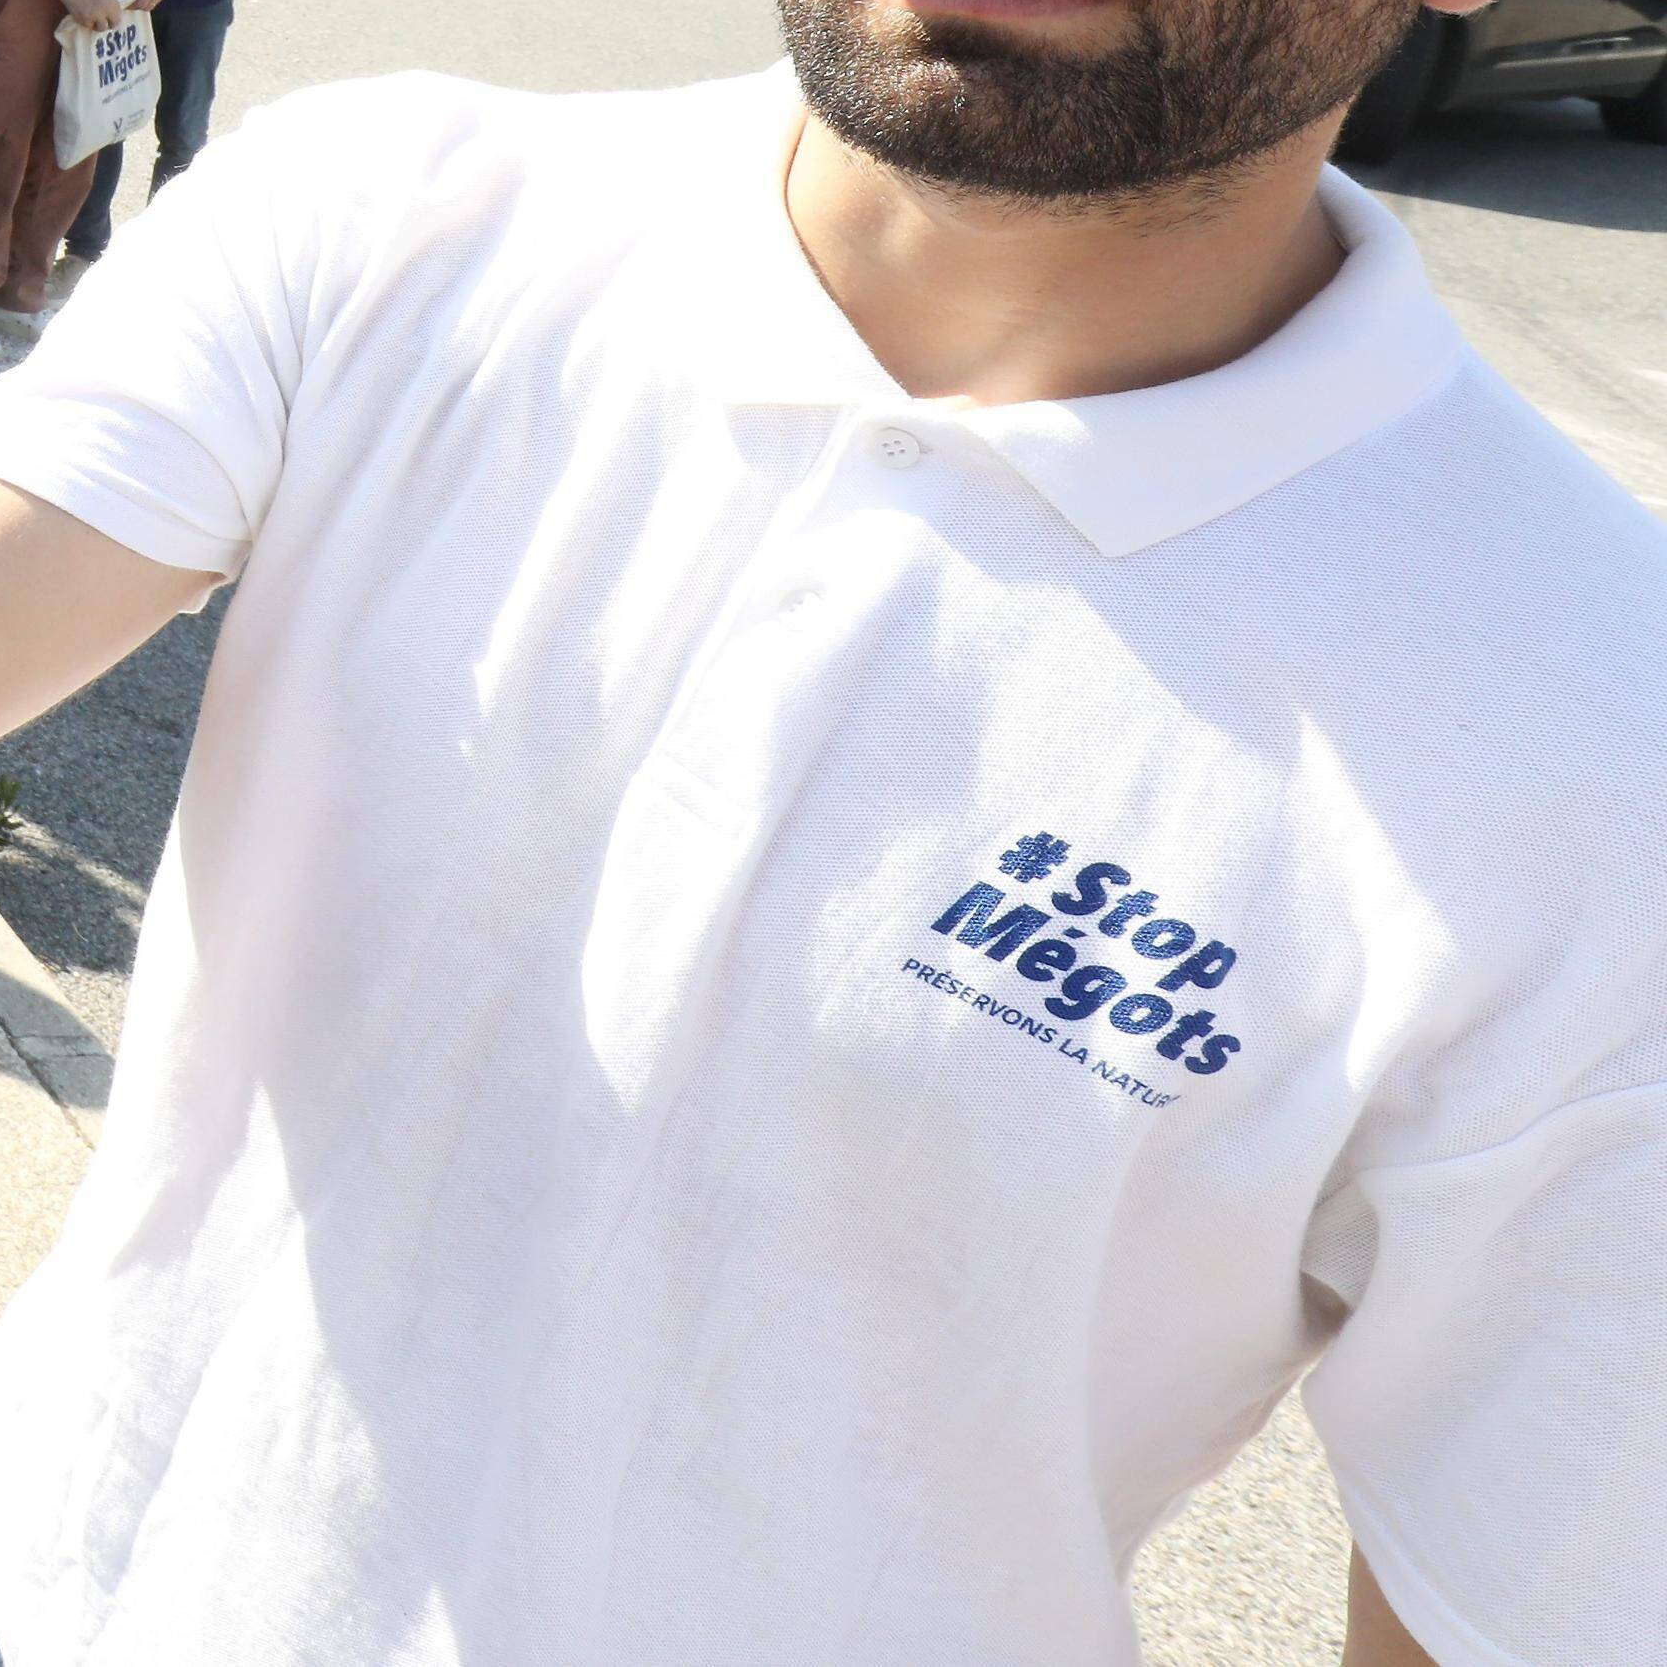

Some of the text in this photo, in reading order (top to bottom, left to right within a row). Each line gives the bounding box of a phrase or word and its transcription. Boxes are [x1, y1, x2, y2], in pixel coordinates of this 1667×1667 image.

[930, 880, 1242, 1075] Mégots
[997, 831, 1237, 994] #Stop
[900, 956, 1058, 1045] PRÉSERVONS
[1058, 1037, 1090, 1065] LA
